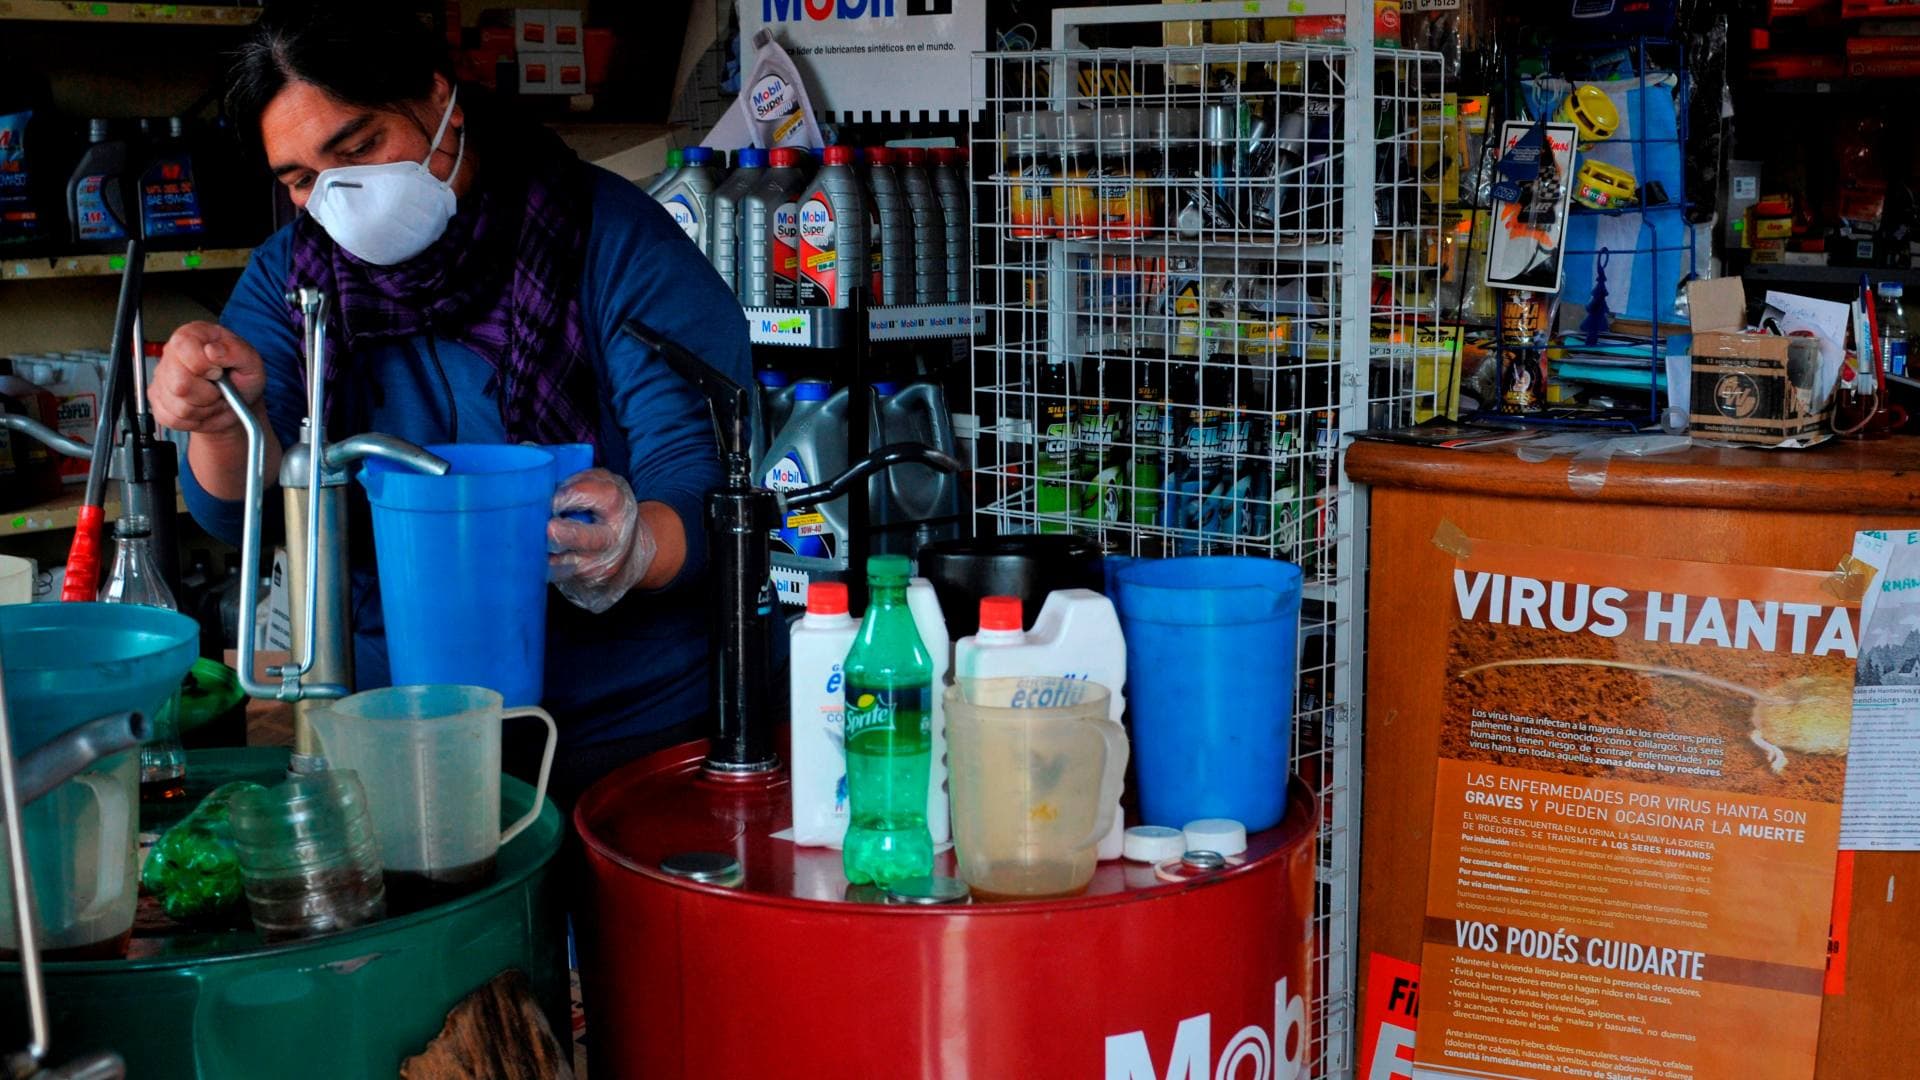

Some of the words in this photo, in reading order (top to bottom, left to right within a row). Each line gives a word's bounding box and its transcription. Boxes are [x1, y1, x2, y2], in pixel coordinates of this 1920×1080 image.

[814, 46, 823, 54] de
[825, 44, 866, 54] lubricantes
[868, 43, 904, 53] sintéticos
[917, 42, 925, 50] el
[753, 80, 782, 106] Mobil
[756, 94, 784, 118] Super
[802, 211, 826, 222] Mobil
[802, 225, 825, 236] Super
[772, 469, 800, 484] Mobil
[1454, 569, 1628, 638] VIRUS
[1644, 591, 1858, 659] HANTA
[846, 704, 889, 733] Sprite
[1470, 739, 1489, 749] virus
[1492, 741, 1516, 753] hanta
[1531, 746, 1554, 758] todas
[1557, 752, 1592, 762] aquellas
[1595, 756, 1622, 766] zonas
[1624, 757, 1655, 769] donde
[1657, 761, 1674, 773] hay
[1677, 764, 1720, 775] roedores.
[1471, 729, 1510, 742] humanos
[1516, 734, 1542, 746] tienen
[1548, 739, 1575, 752] riesgo
[1580, 742, 1590, 752] de
[1595, 745, 1632, 756] contraer
[1637, 749, 1701, 763] enfermedades
[1707, 758, 1722, 767] por
[1467, 772, 1494, 788] LAS
[1500, 776, 1623, 804] ENFERMEDADES
[1628, 791, 1660, 808] POR
[1665, 795, 1710, 813] VIRUS
[1716, 801, 1768, 820] HANTA
[1772, 807, 1806, 824] SON
[1465, 790, 1523, 810] GRAVES
[1530, 798, 1538, 812] Y
[1545, 800, 1607, 820] PUEDEN
[1615, 808, 1704, 831] OCASIONAR
[1711, 818, 1731, 833] LA
[1739, 821, 1804, 840] MUERTE
[1462, 821, 1473, 831] DE
[1478, 823, 1527, 838] ROEDORES.
[1532, 830, 1542, 840] SE
[1546, 832, 1597, 846] TRANSMITE
[1601, 839, 1607, 848] A
[1611, 840, 1627, 850] LOS
[1631, 842, 1661, 854] SERES
[1455, 920, 1498, 952] VOS
[1505, 927, 1579, 964] PODÉS
[1586, 938, 1704, 980] CUIDARTE
